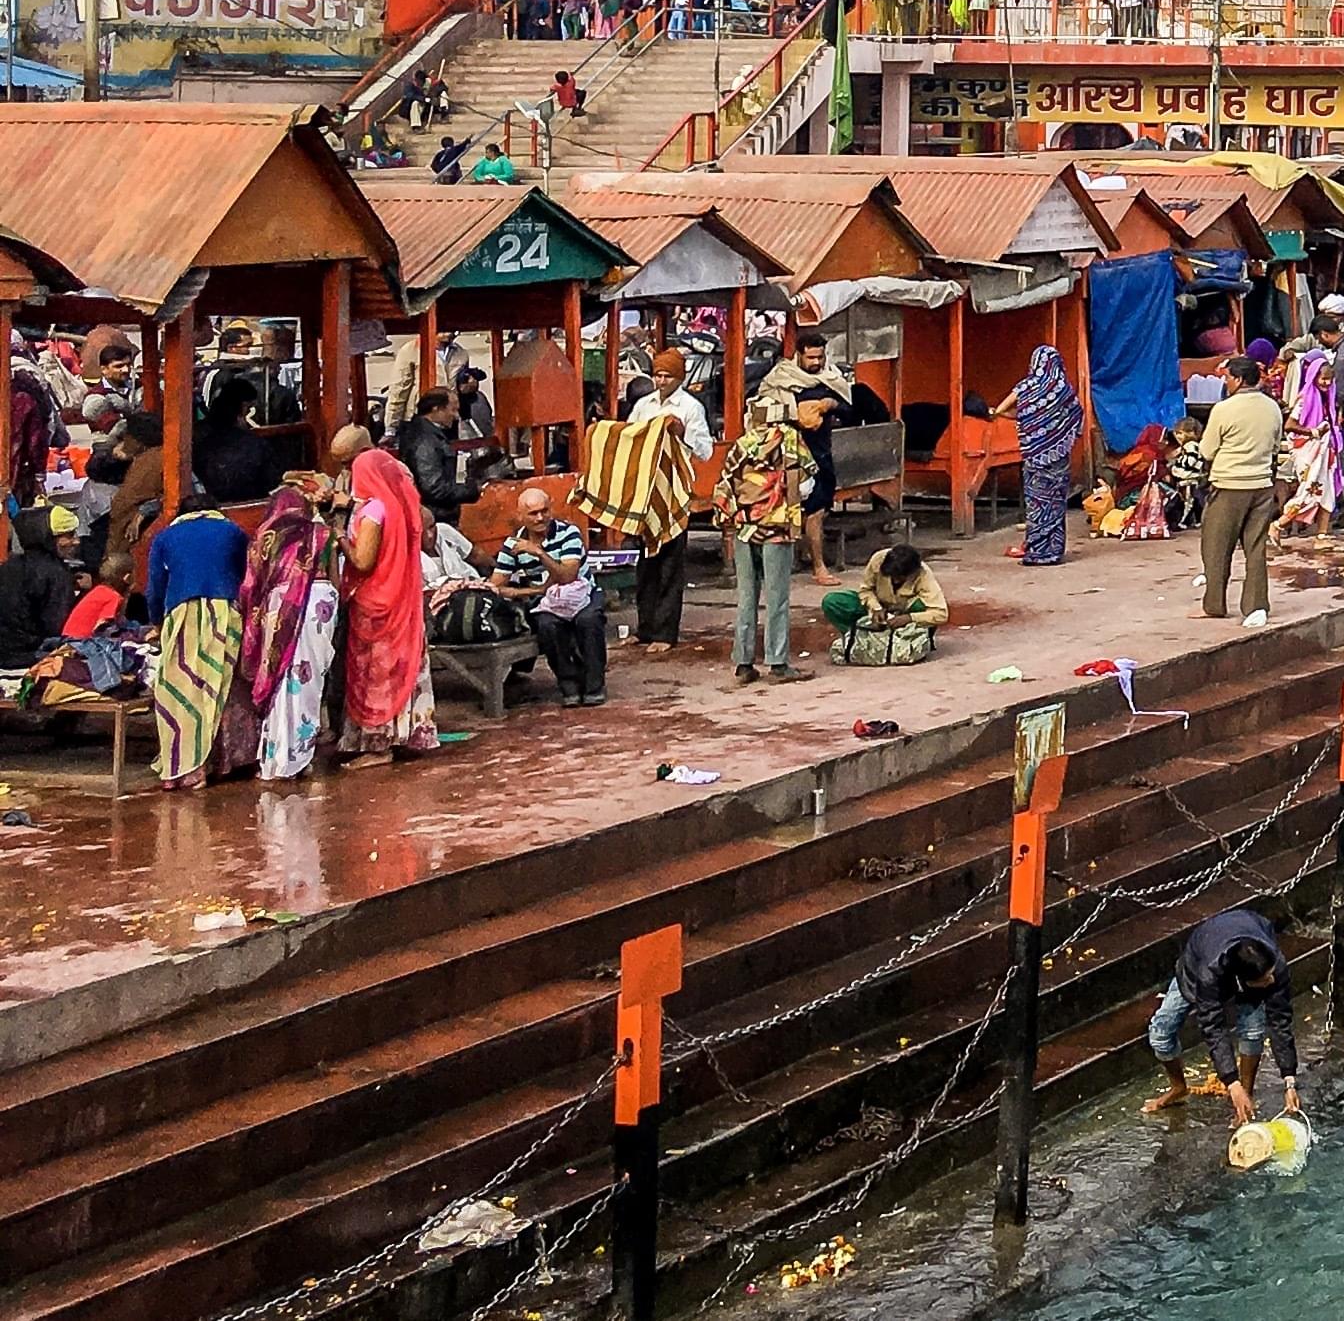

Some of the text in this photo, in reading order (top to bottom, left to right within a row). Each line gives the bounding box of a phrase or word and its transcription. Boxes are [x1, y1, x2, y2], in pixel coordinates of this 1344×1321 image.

[1036, 77, 1143, 113] अस्थि
[1154, 85, 1251, 121] प्रवह
[1264, 85, 1340, 116] घाट
[496, 233, 550, 273] 24
